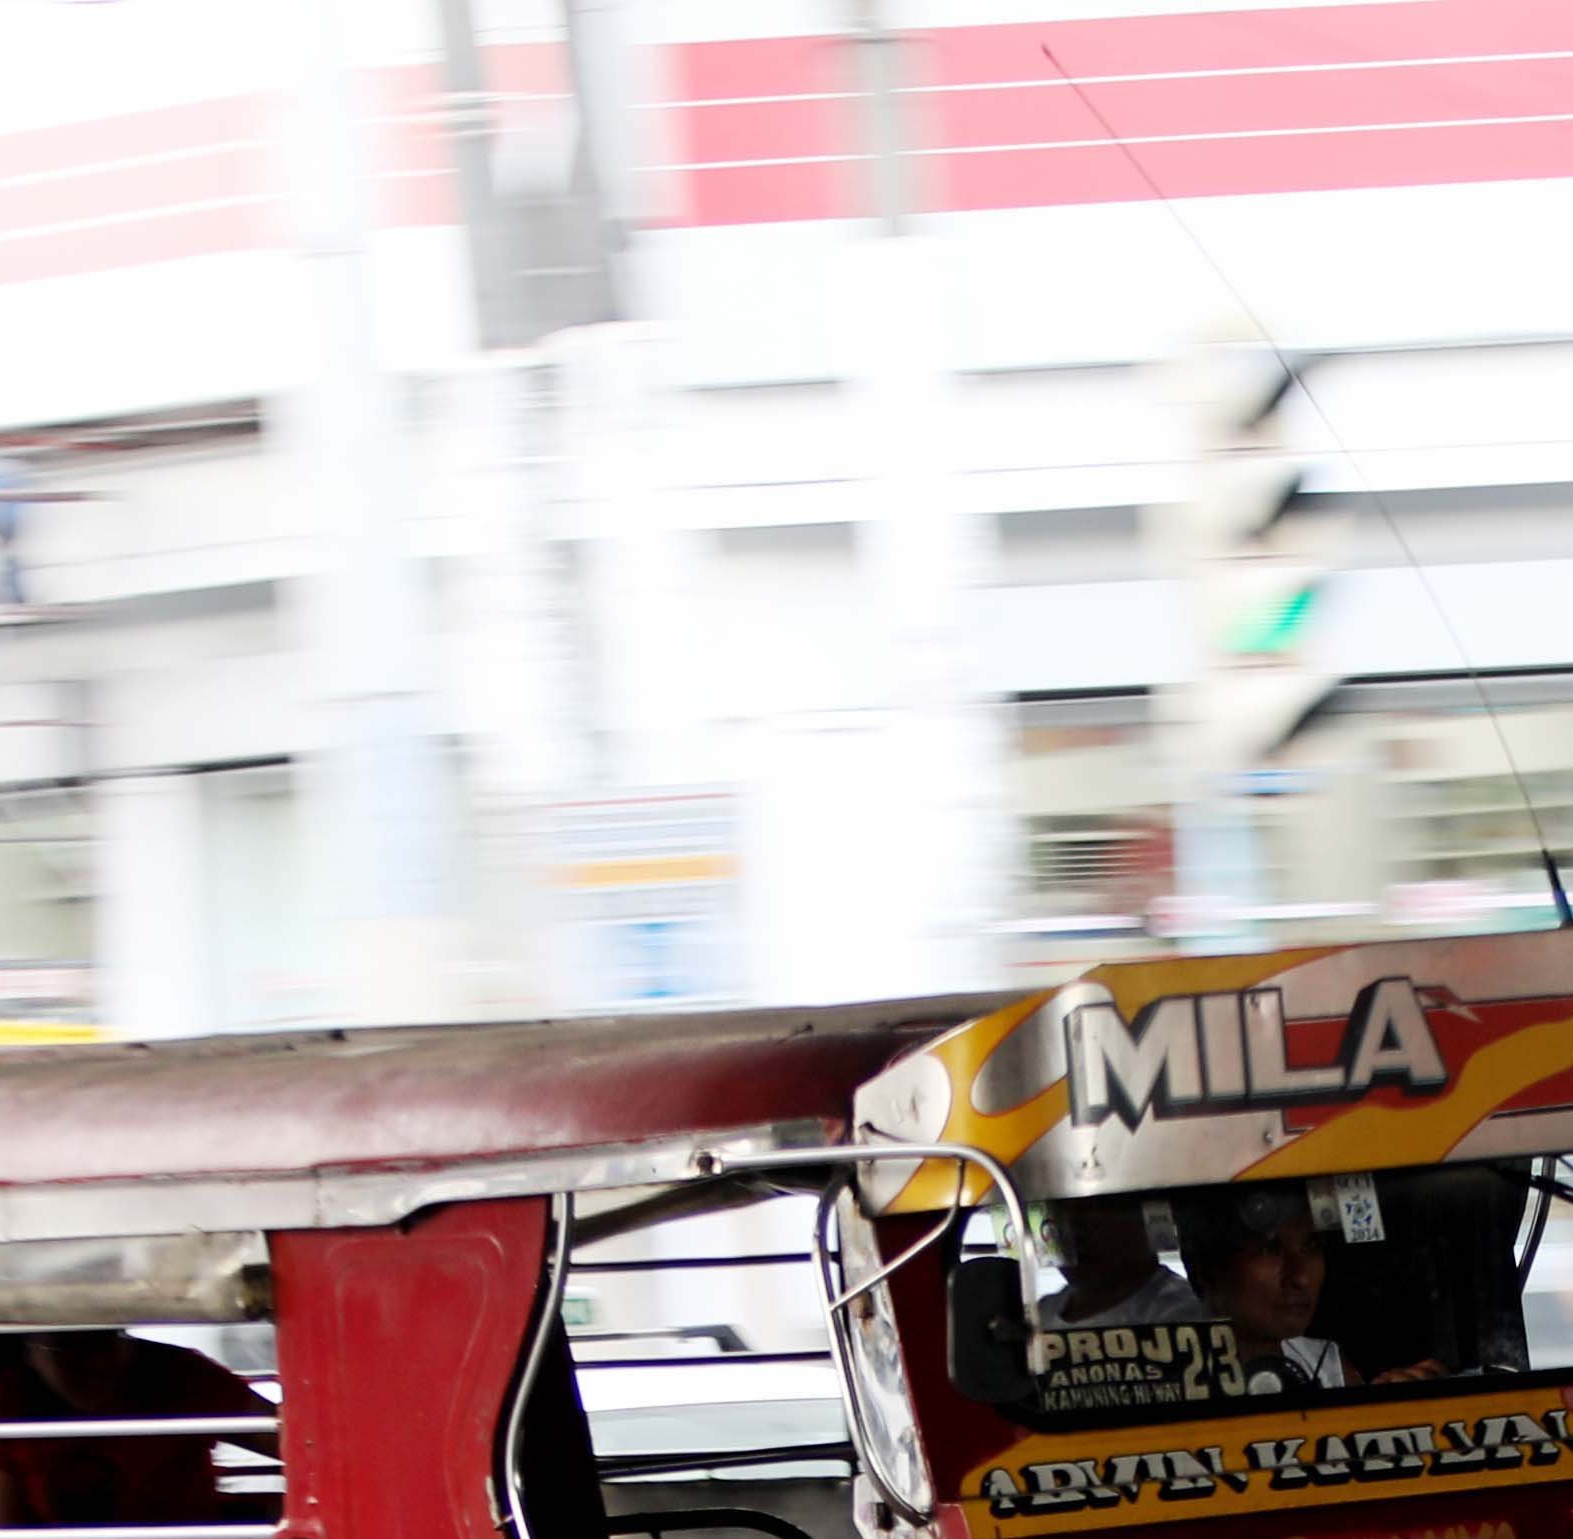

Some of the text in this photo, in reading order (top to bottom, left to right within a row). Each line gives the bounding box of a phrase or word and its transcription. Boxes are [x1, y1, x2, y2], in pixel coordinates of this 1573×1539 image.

[1068, 976, 1447, 1130] MILA
[1034, 1325, 1175, 1372] PROJ
[1049, 1360, 1163, 1389] ANONAS
